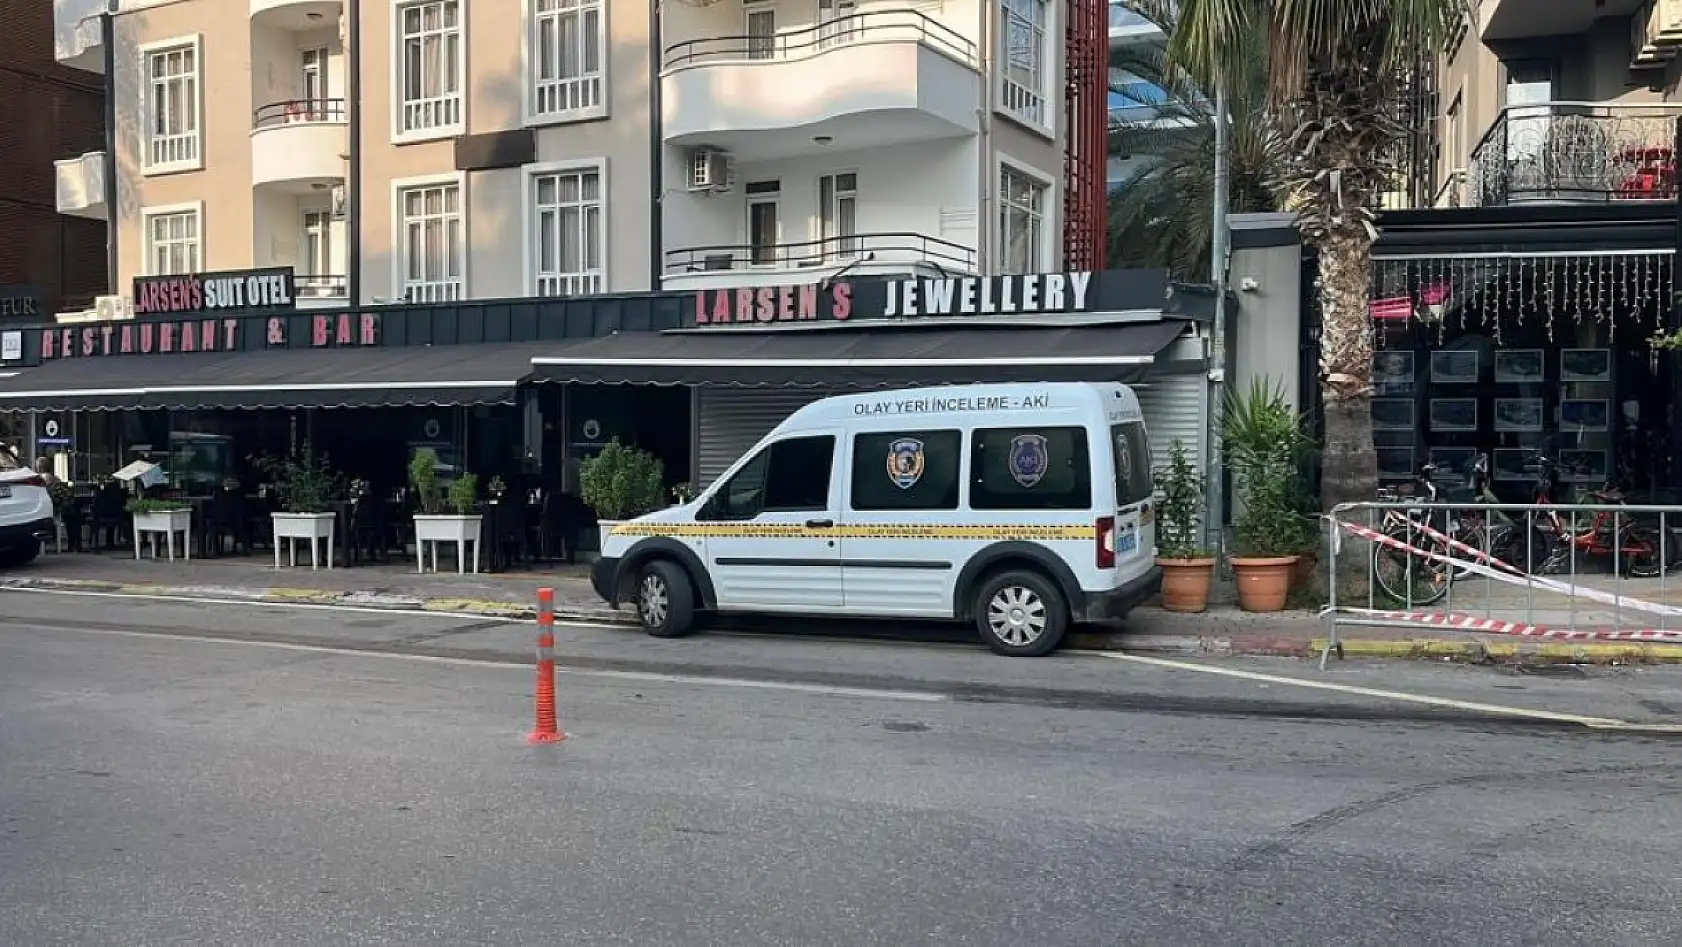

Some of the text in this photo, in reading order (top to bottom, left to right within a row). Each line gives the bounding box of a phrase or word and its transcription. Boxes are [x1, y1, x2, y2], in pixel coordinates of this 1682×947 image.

[134, 274, 291, 312] LARSEN'S SUIT OTEL
[695, 271, 1092, 324] LARSEN'S JEWELLERY
[41, 312, 375, 358] RESTAURANT & BAR
[854, 402, 891, 415] OLAY
